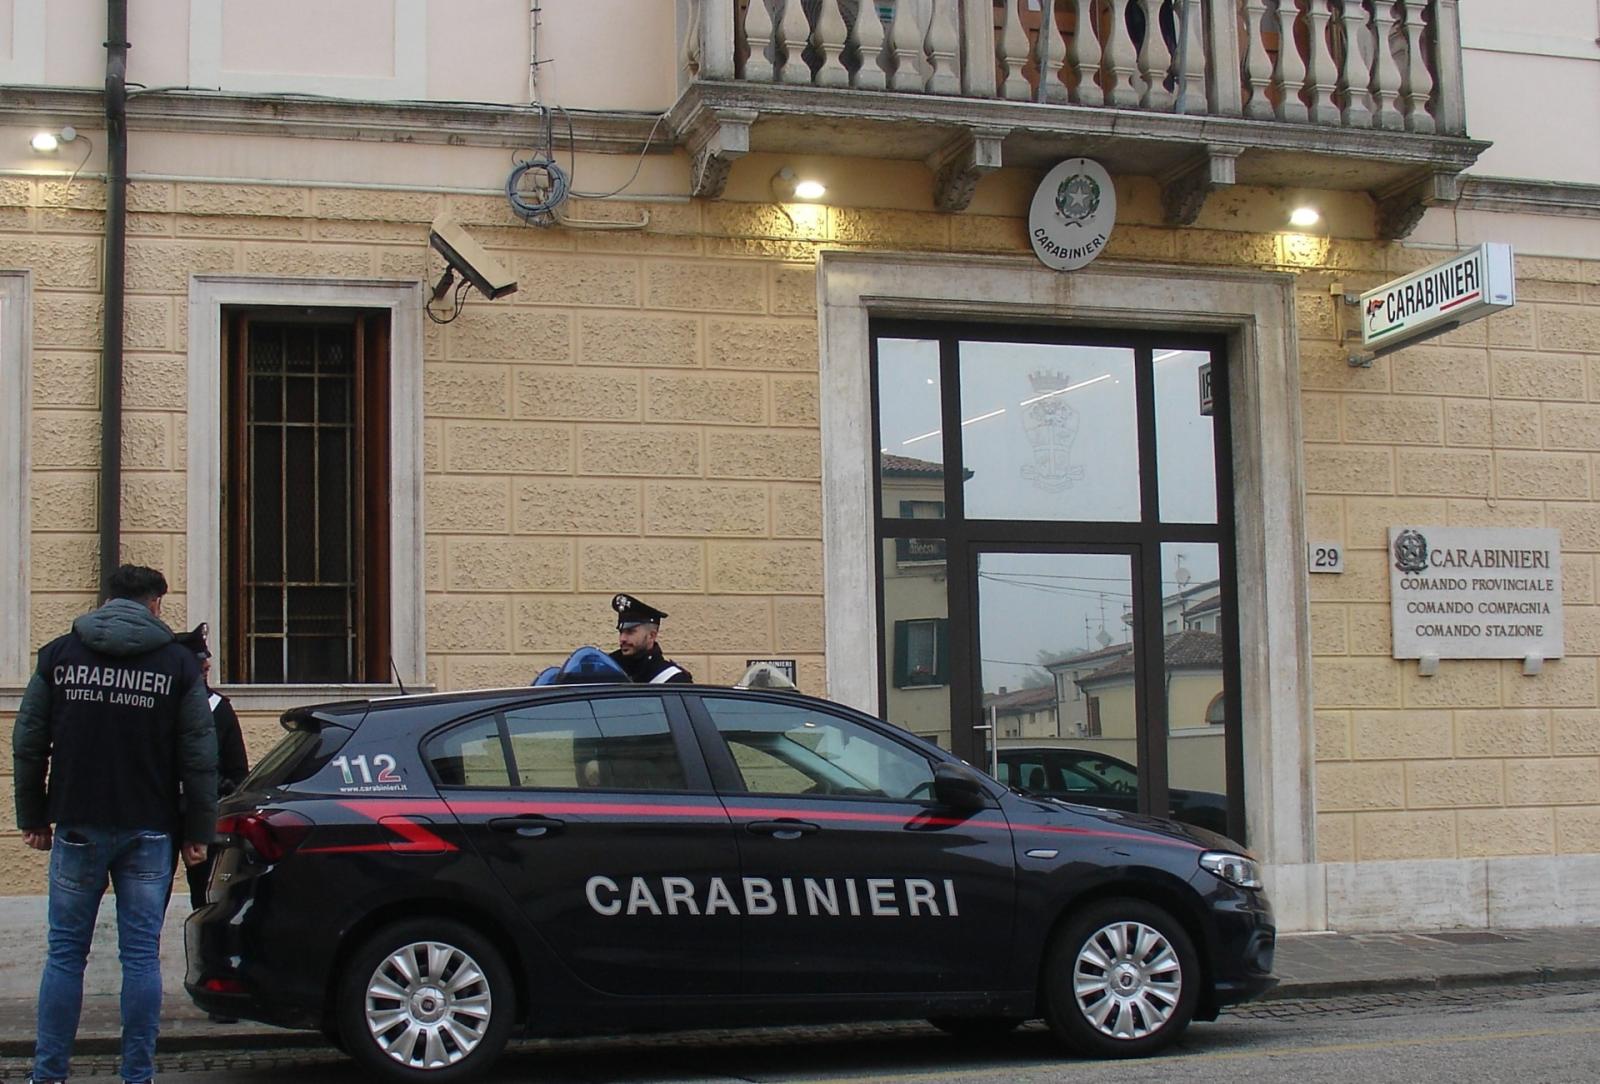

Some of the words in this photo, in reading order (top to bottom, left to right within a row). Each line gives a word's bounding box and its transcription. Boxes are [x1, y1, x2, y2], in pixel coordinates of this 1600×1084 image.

[1034, 228, 1106, 259] CARABINIERI
[1386, 257, 1480, 323] CARABINIERI
[1315, 548, 1338, 567] 29
[1430, 549, 1550, 569] CARABINIERI
[1400, 578, 1467, 591] COMANDO
[1472, 579, 1553, 592] PROVINCIALE
[1406, 602, 1474, 615] COMANDO
[1478, 602, 1550, 615] COMPAGNIA
[1415, 625, 1481, 637] COMANDO
[1486, 625, 1543, 637] STAZIONE
[53, 665, 173, 695] CARABINIERI
[65, 688, 104, 702] TUTELA
[109, 692, 155, 709] LAVORO
[331, 753, 402, 784] 112
[340, 784, 408, 793] www.carabinieri.it
[585, 875, 960, 917] CARABINIERI
